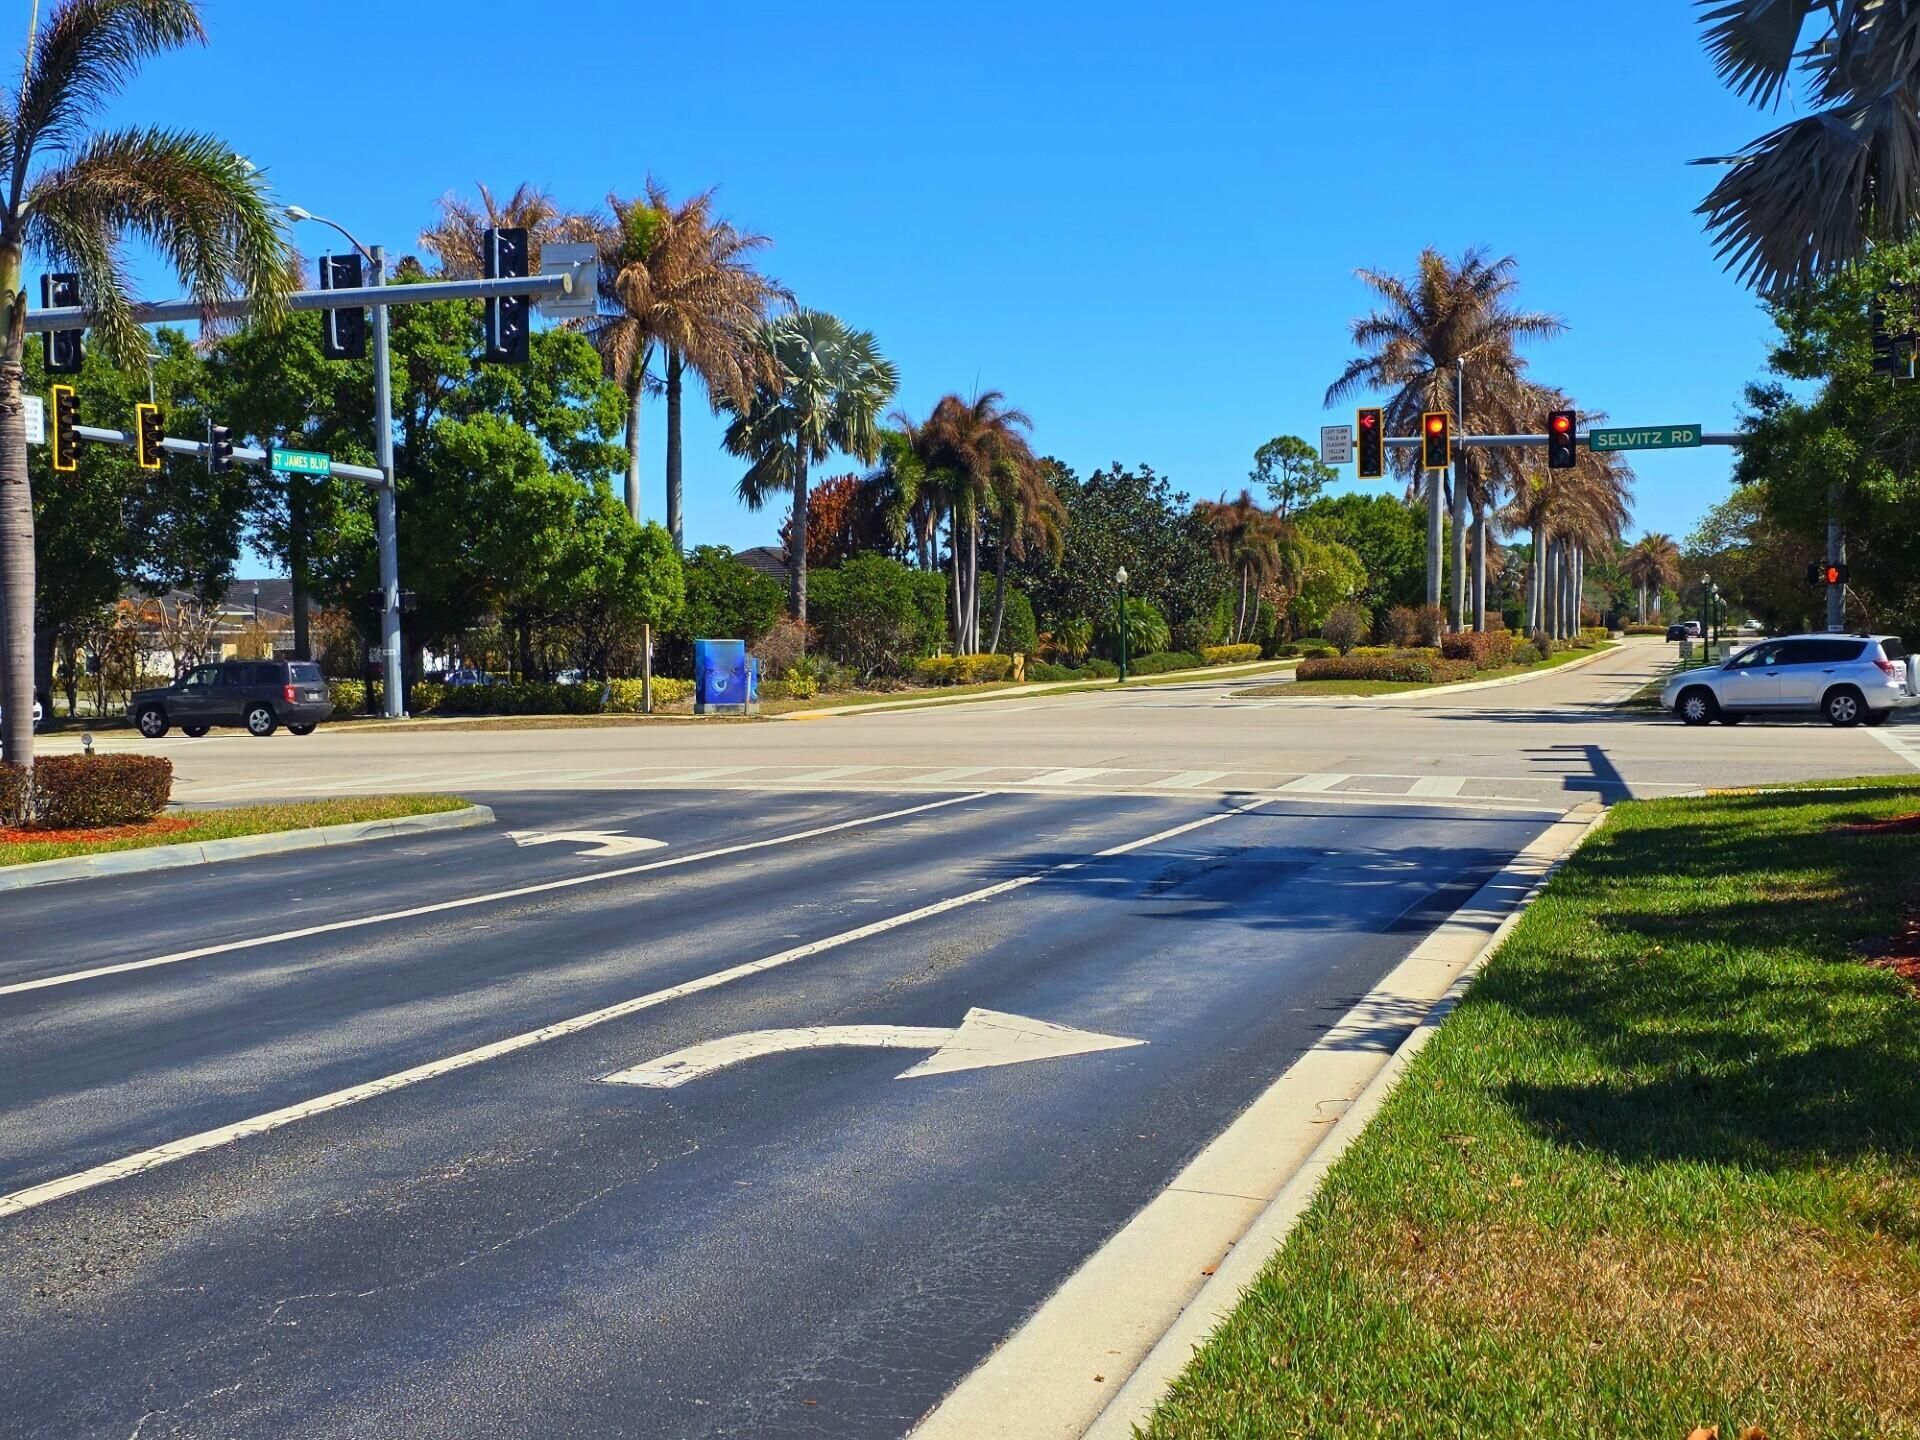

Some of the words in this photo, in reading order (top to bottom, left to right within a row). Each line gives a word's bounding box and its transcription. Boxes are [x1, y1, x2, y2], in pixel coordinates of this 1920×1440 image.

[1598, 432, 1663, 446] SELVITZ
[1671, 430, 1694, 443] RD
[273, 454, 282, 466] ST
[284, 455, 308, 468] JAMES
[310, 457, 328, 470] BLVD
